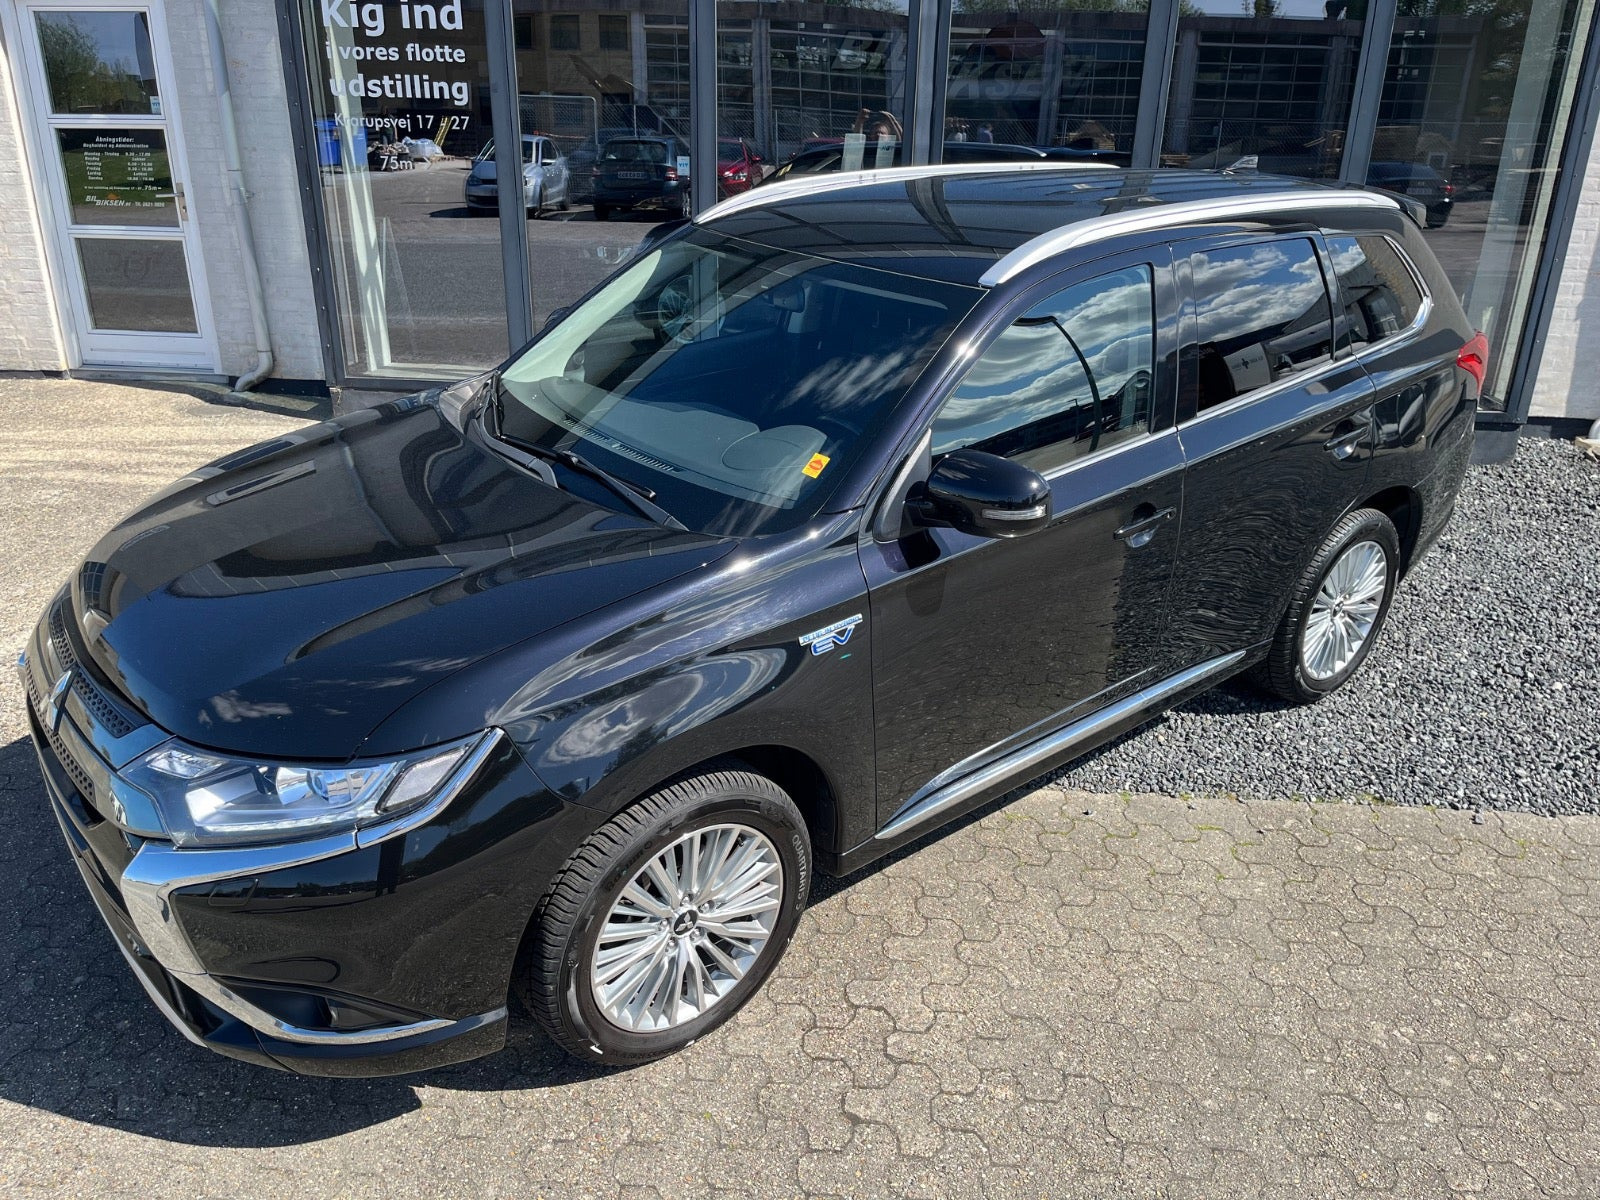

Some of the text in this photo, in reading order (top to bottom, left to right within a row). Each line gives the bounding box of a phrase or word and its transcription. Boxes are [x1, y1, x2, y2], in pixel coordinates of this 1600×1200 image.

[321, 0, 463, 37] Kig ind
[325, 41, 466, 63] i vores flotte
[329, 73, 470, 106] udstilling
[416, 114, 434, 129] 17
[451, 115, 470, 131] 27
[379, 155, 414, 171] 75m
[811, 625, 855, 656] EV
